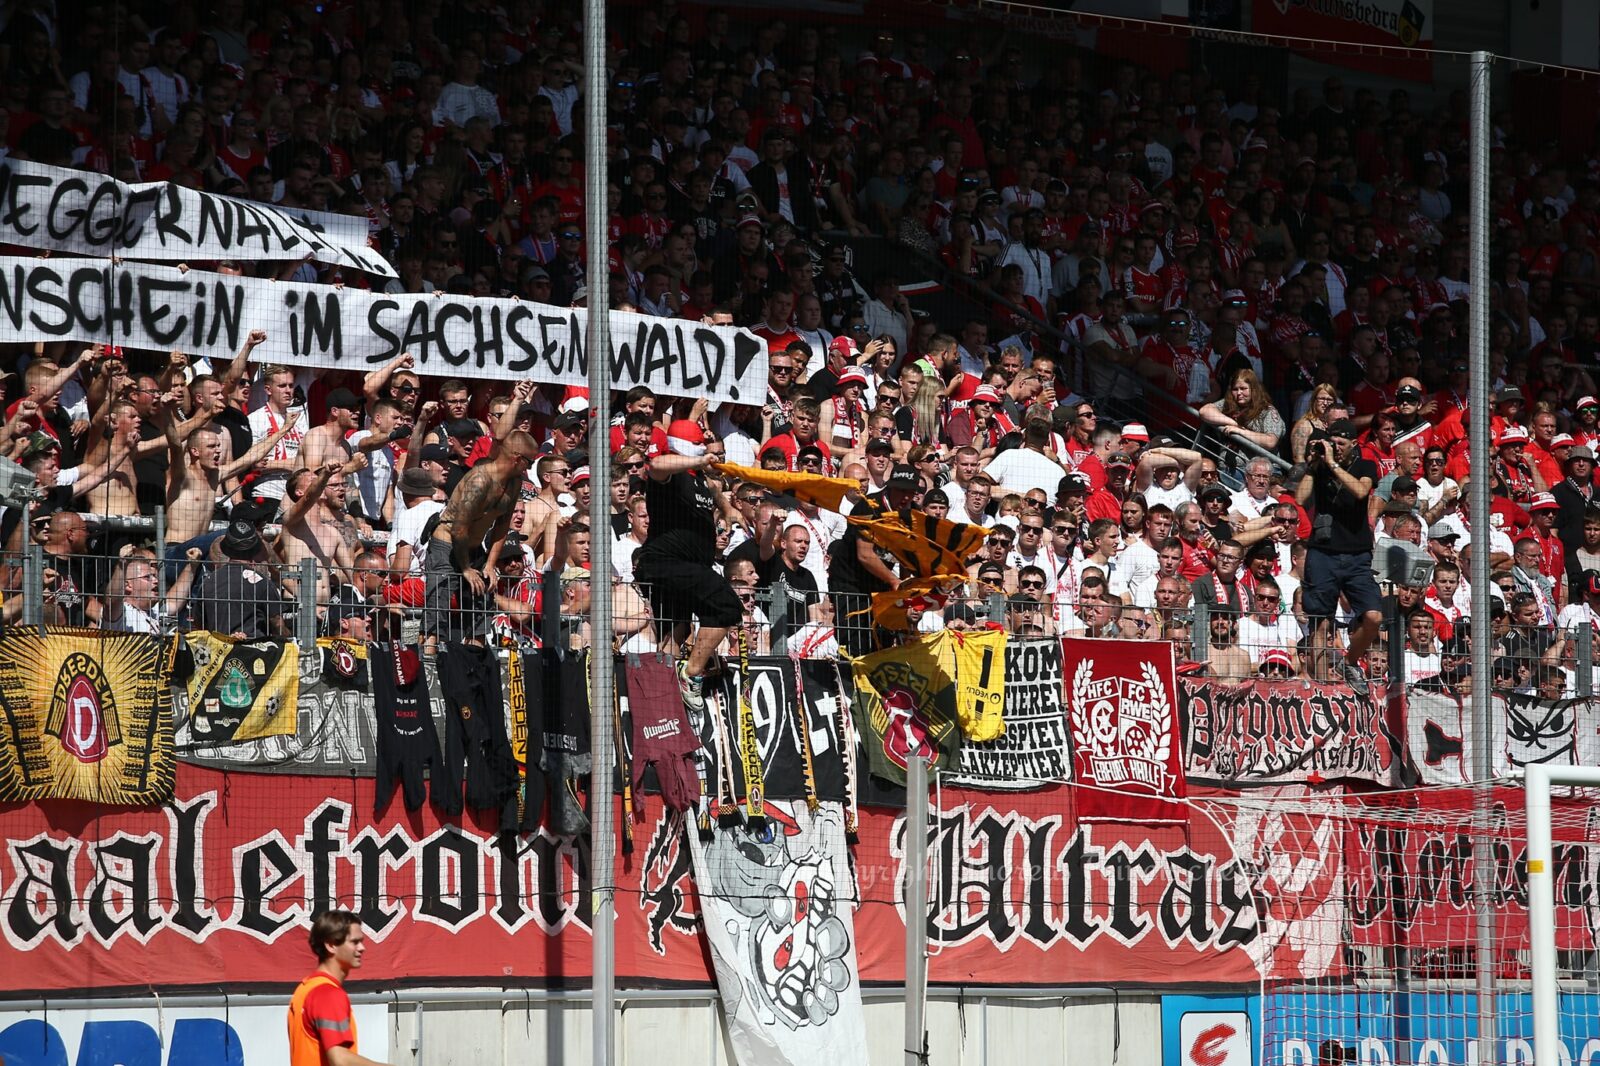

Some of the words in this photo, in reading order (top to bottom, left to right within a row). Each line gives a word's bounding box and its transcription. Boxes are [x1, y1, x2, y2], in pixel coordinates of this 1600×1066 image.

[1087, 679, 1113, 699] HFC
[1127, 683, 1146, 702] FC
[1121, 700, 1151, 720] RWE
[888, 802, 1276, 953] Ultras
